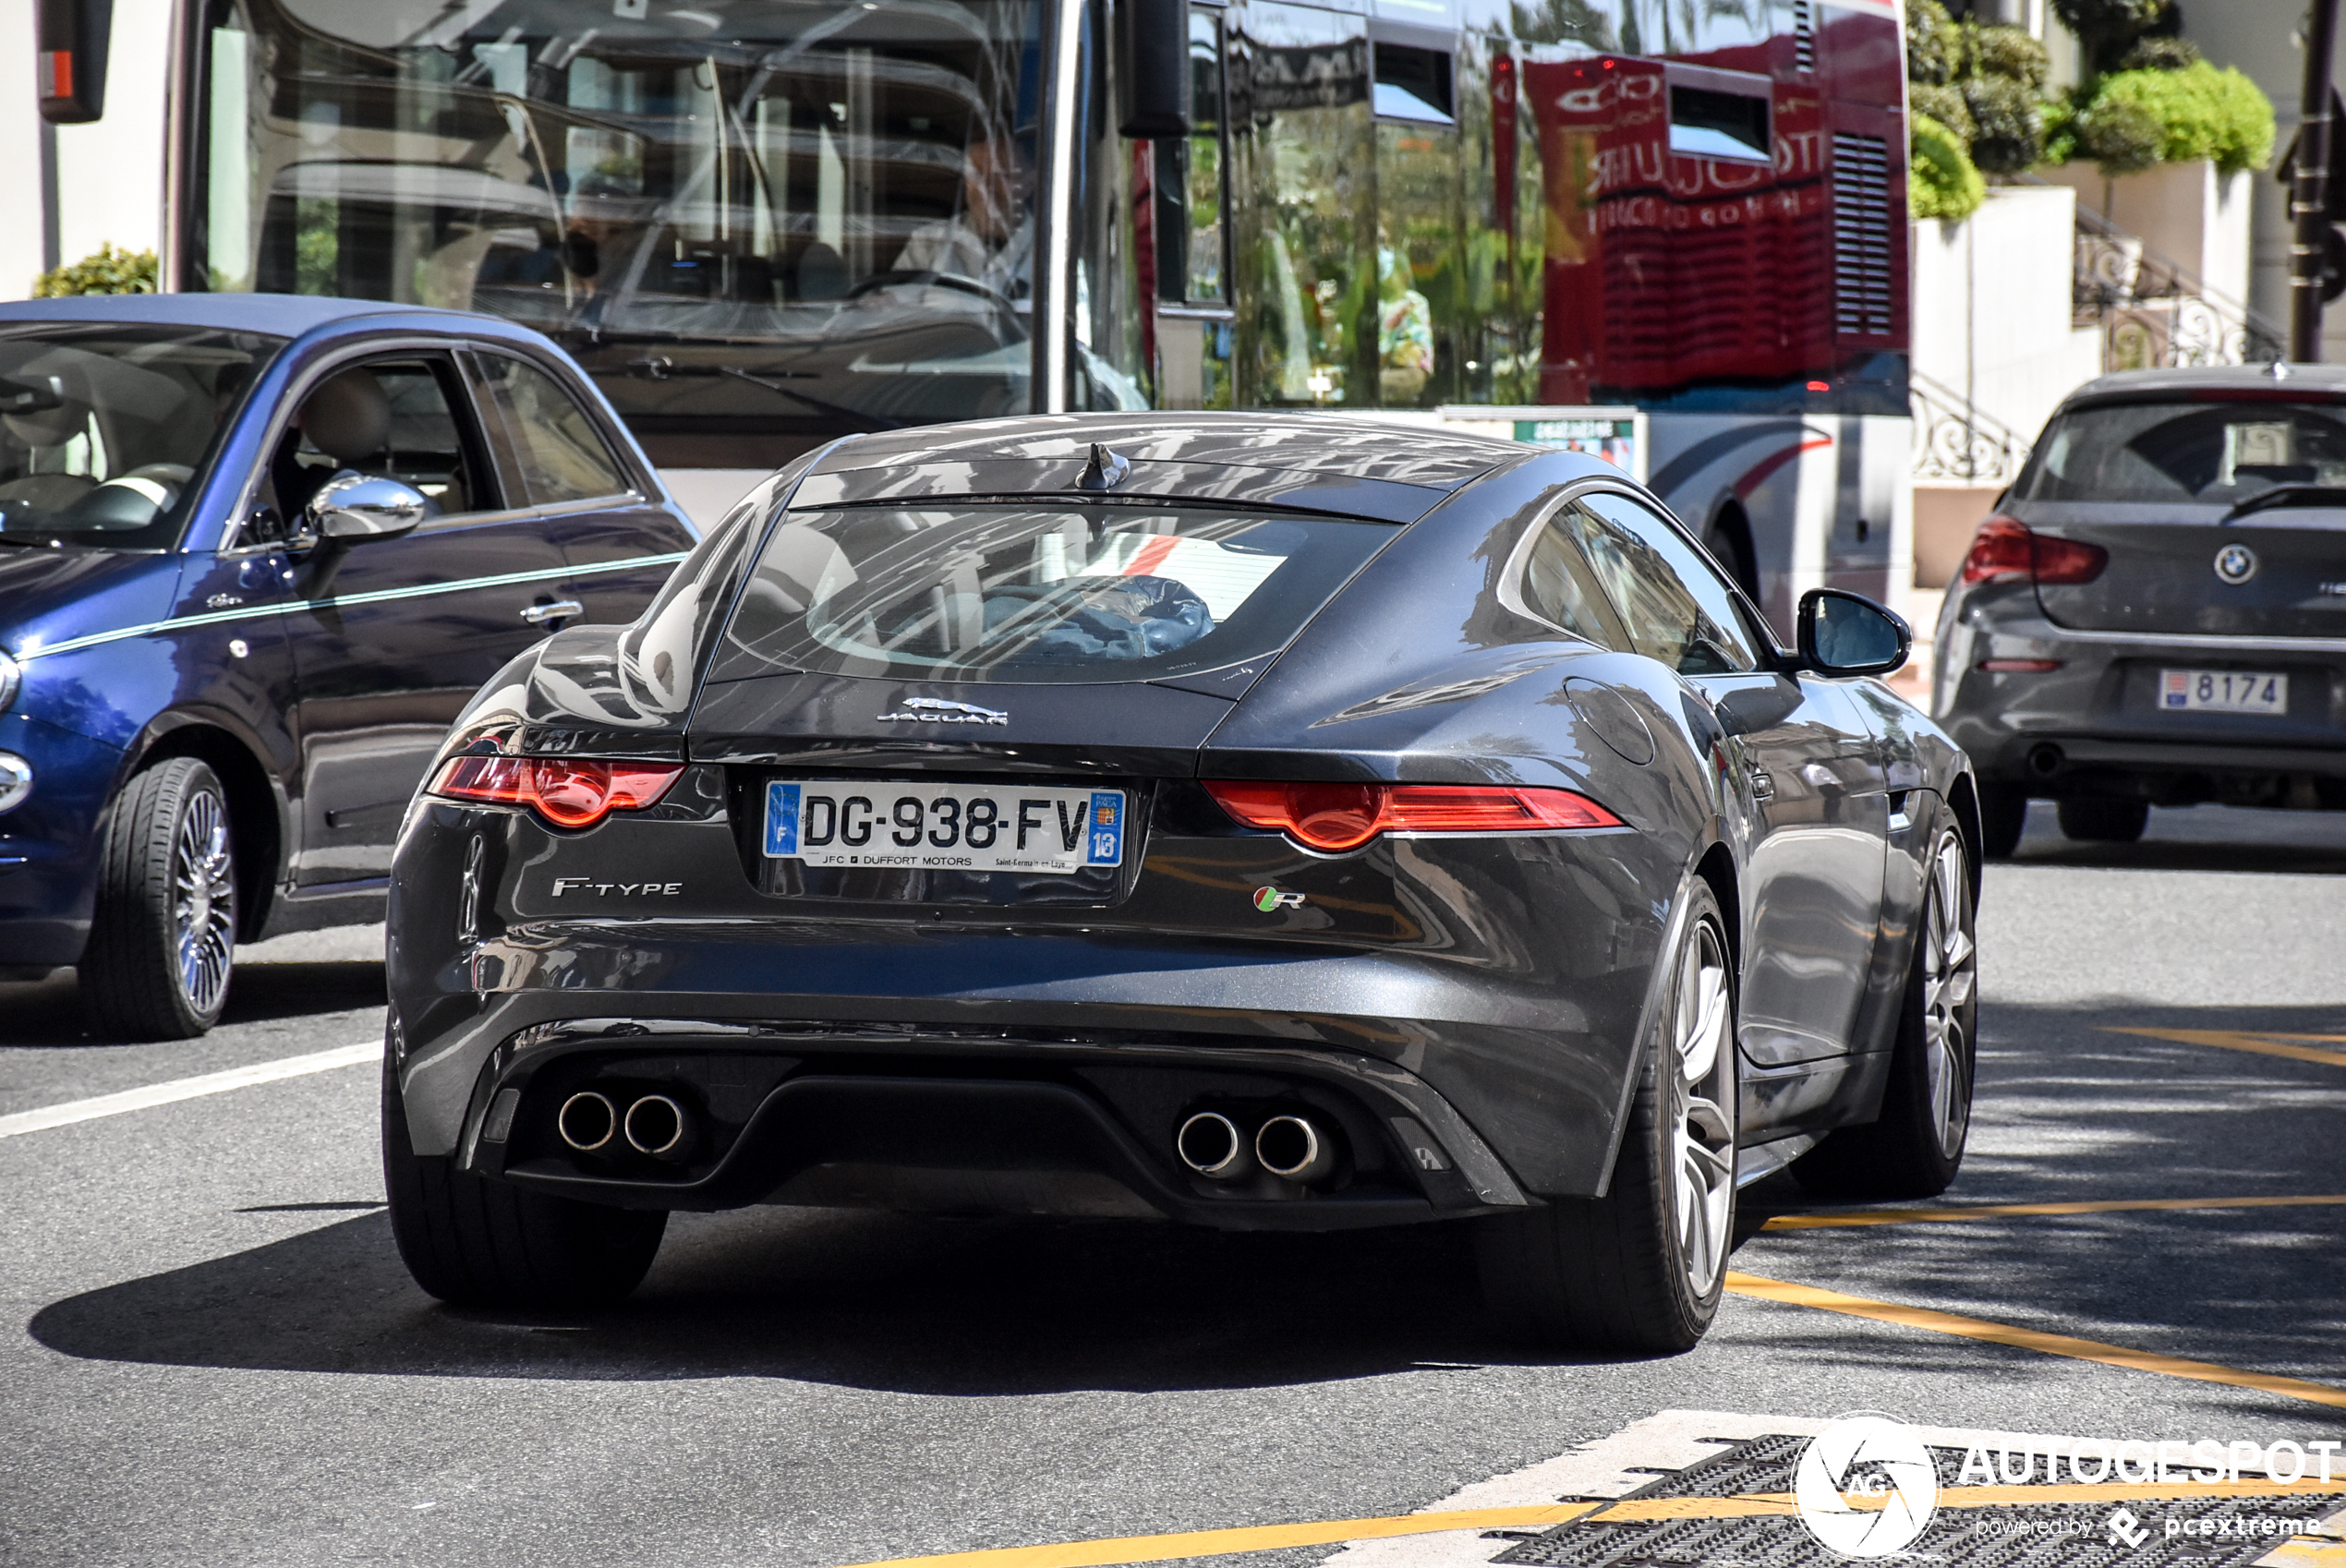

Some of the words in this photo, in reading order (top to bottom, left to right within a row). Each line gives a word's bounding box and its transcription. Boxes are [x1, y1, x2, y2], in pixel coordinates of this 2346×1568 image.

[2197, 675, 2277, 705] 8174
[877, 713, 1008, 726] JAGUAR
[804, 796, 1088, 851] DG-938-FV
[777, 826, 787, 842] F
[1093, 832, 1115, 858] 13
[823, 855, 844, 864] JFC
[864, 856, 917, 865] DUFFORT
[923, 857, 973, 866] MOTORS
[996, 858, 1066, 869] Saint-Germain-en-Laye
[551, 877, 683, 897] F-TYPE
[1269, 892, 1305, 910] R
